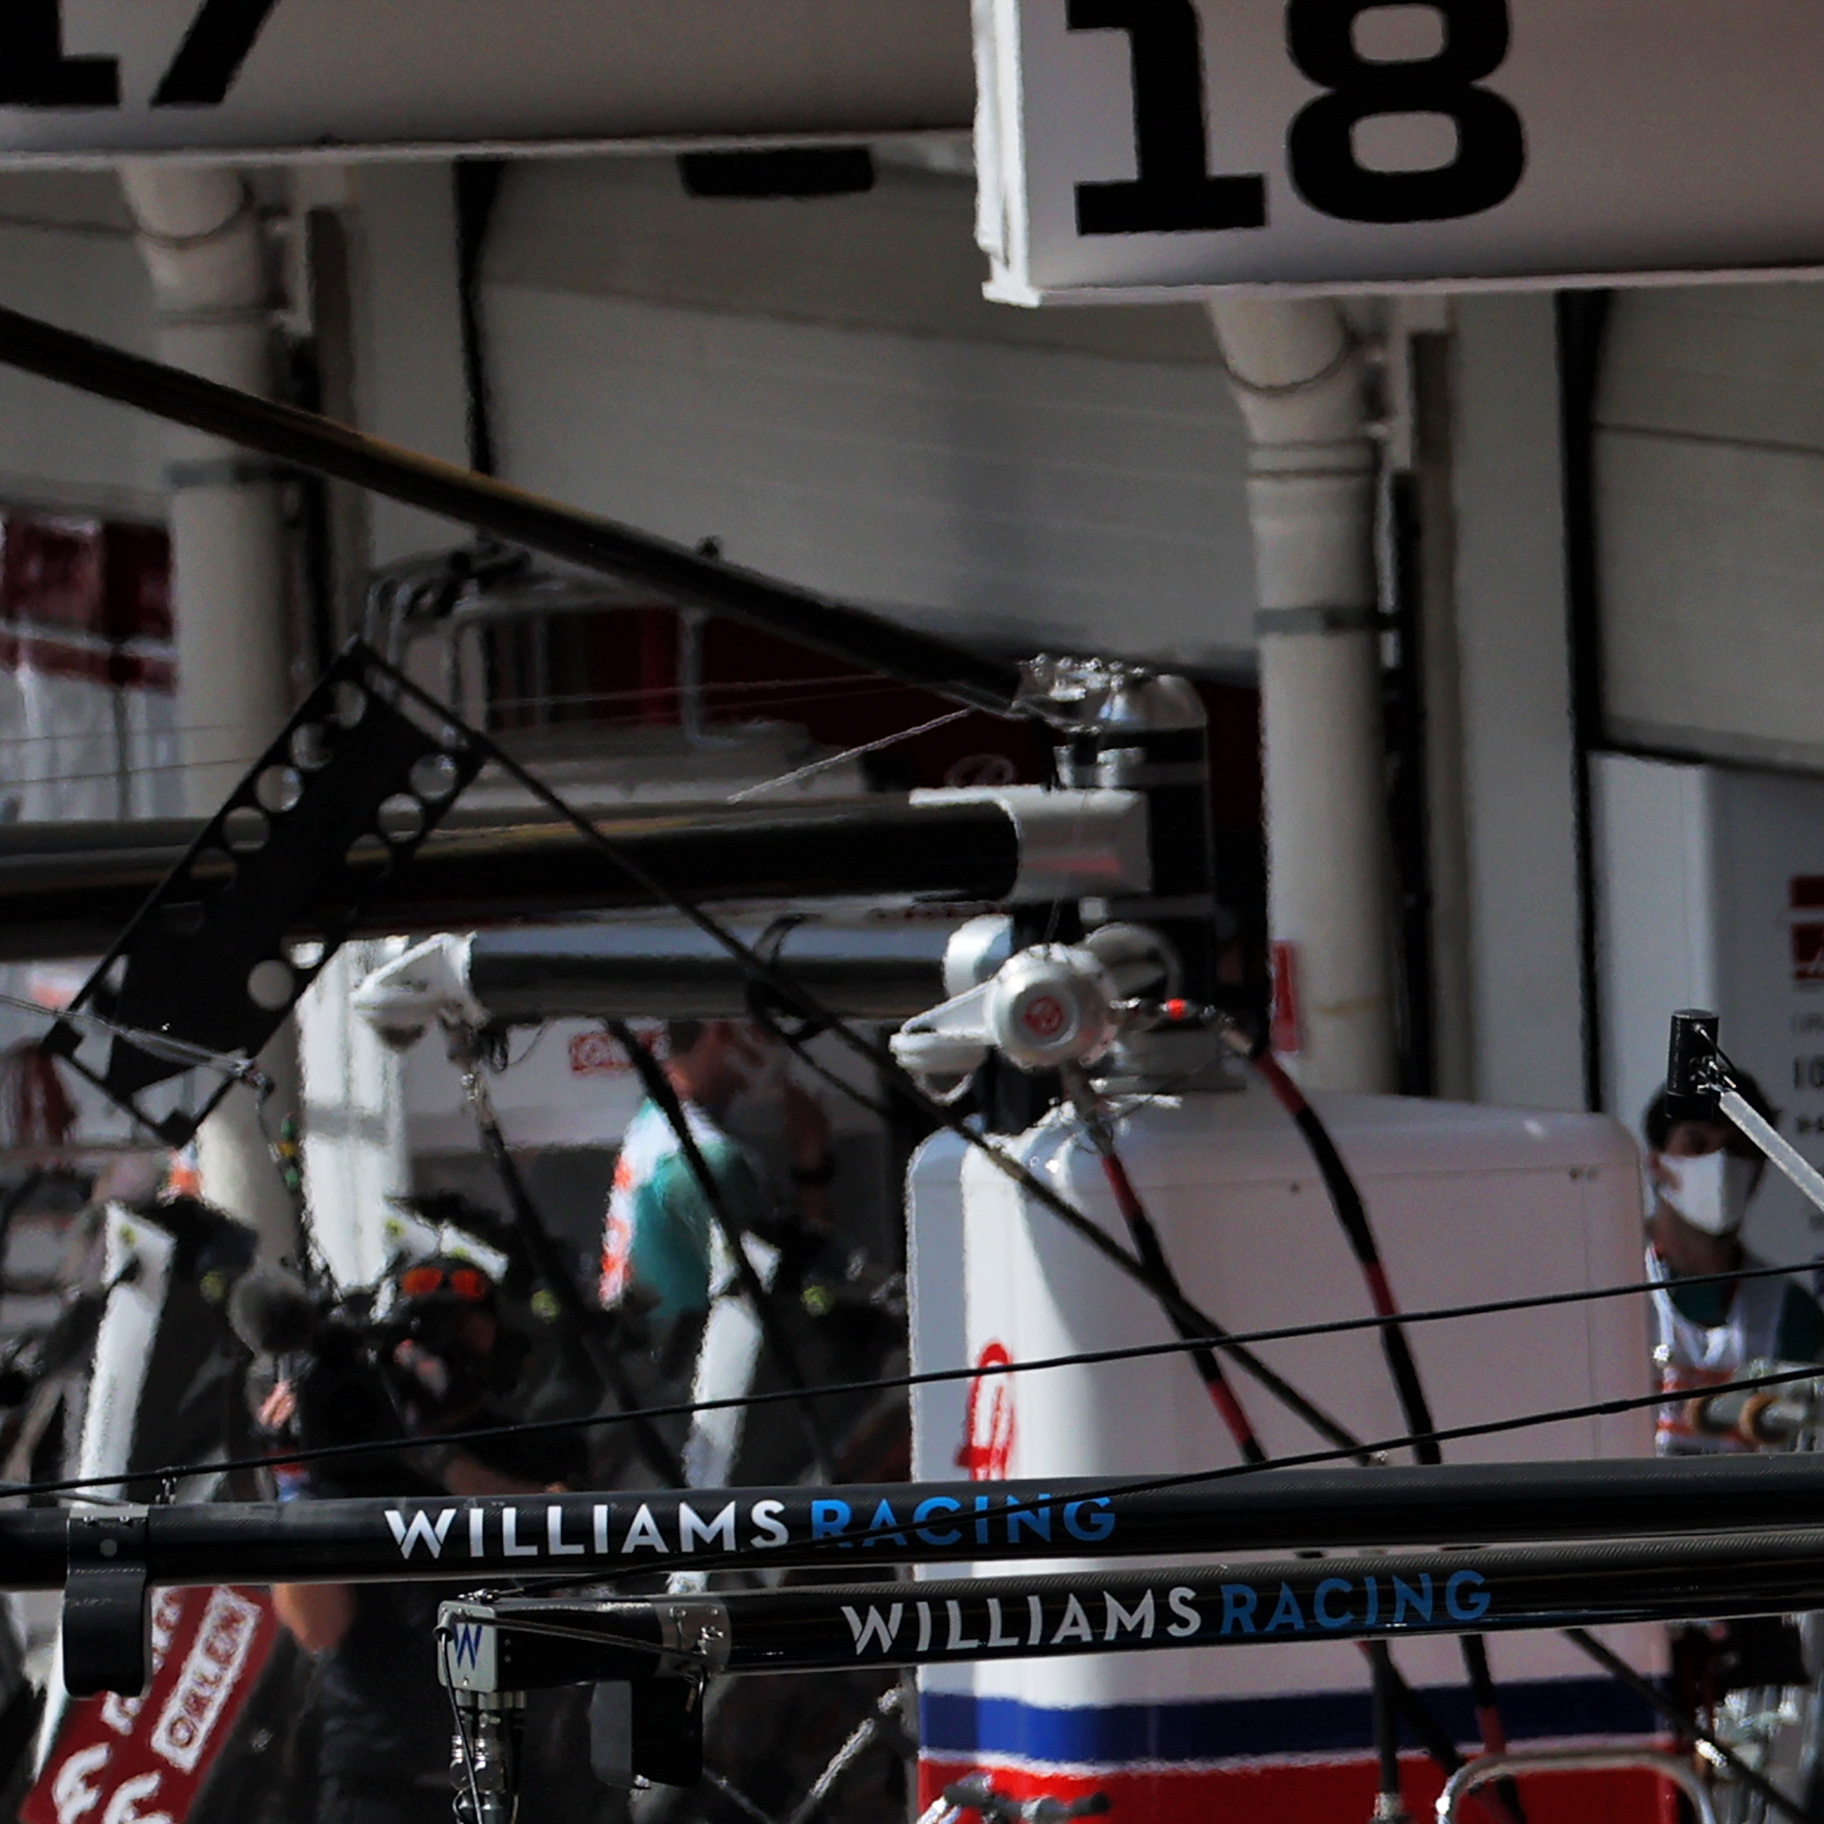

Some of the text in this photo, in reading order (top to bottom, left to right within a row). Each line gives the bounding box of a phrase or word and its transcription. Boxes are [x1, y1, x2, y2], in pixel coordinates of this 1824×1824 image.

[1068, 0, 1527, 237] 18
[384, 1492, 1116, 1560] WILLIAMS RACING
[841, 1570, 1492, 1656] WILLIAMS RACING
